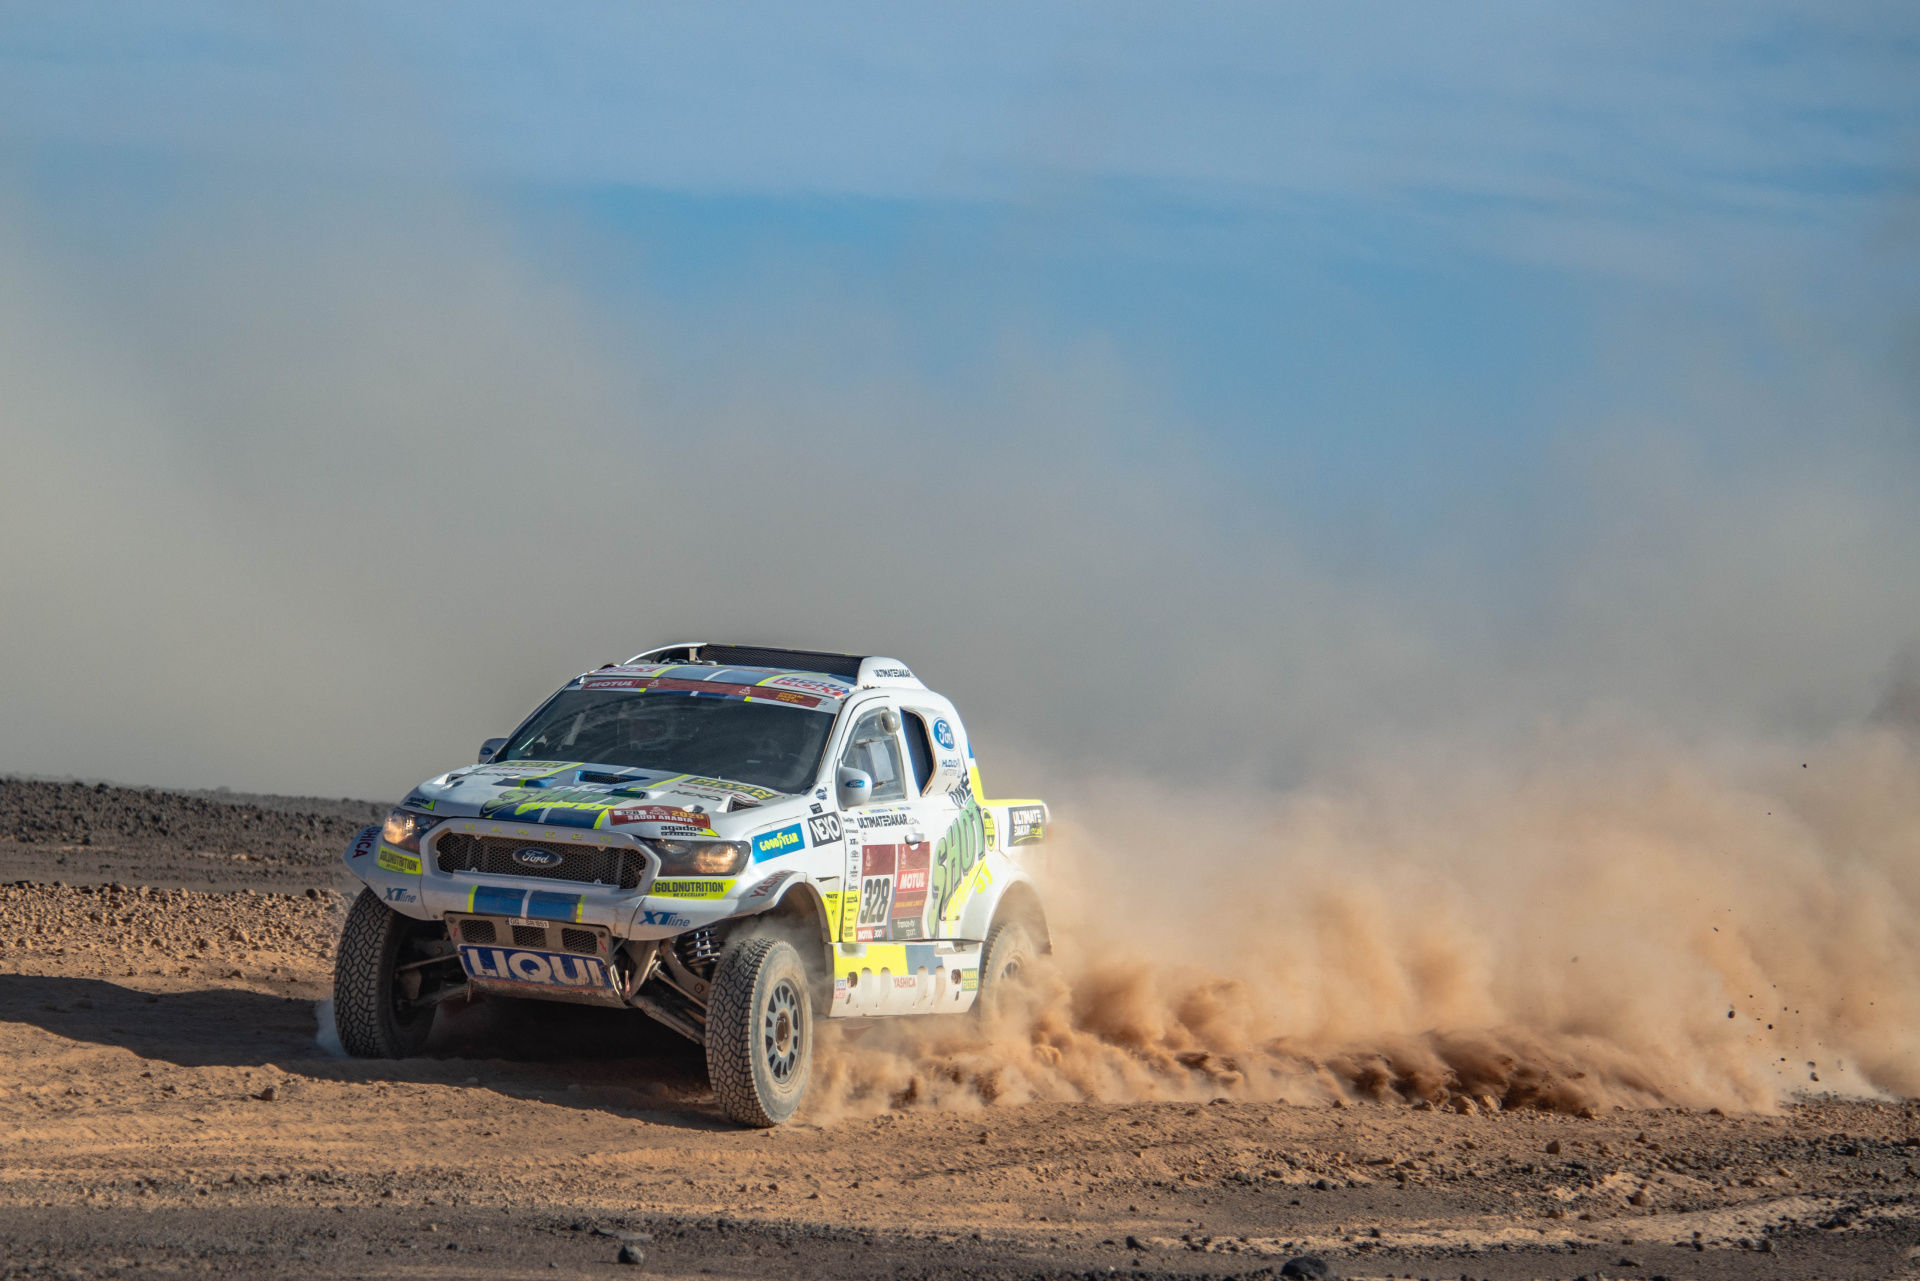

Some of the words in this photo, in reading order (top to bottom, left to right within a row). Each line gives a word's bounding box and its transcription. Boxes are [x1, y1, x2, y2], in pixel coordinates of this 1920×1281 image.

[658, 815, 693, 823] ARABIA
[671, 811, 704, 819] 2020
[808, 815, 841, 842] NEXO
[759, 832, 799, 851] GOODYEAR
[521, 850, 550, 864] Ford
[928, 795, 985, 939] SHOT
[654, 881, 724, 893] GOLDNUTRITION
[900, 872, 925, 890] MOTUL
[383, 887, 417, 903] XTline
[860, 878, 890, 924] 328
[639, 911, 690, 928] XTline
[468, 948, 605, 987] LIQUI
[893, 976, 917, 989] YASHICA
